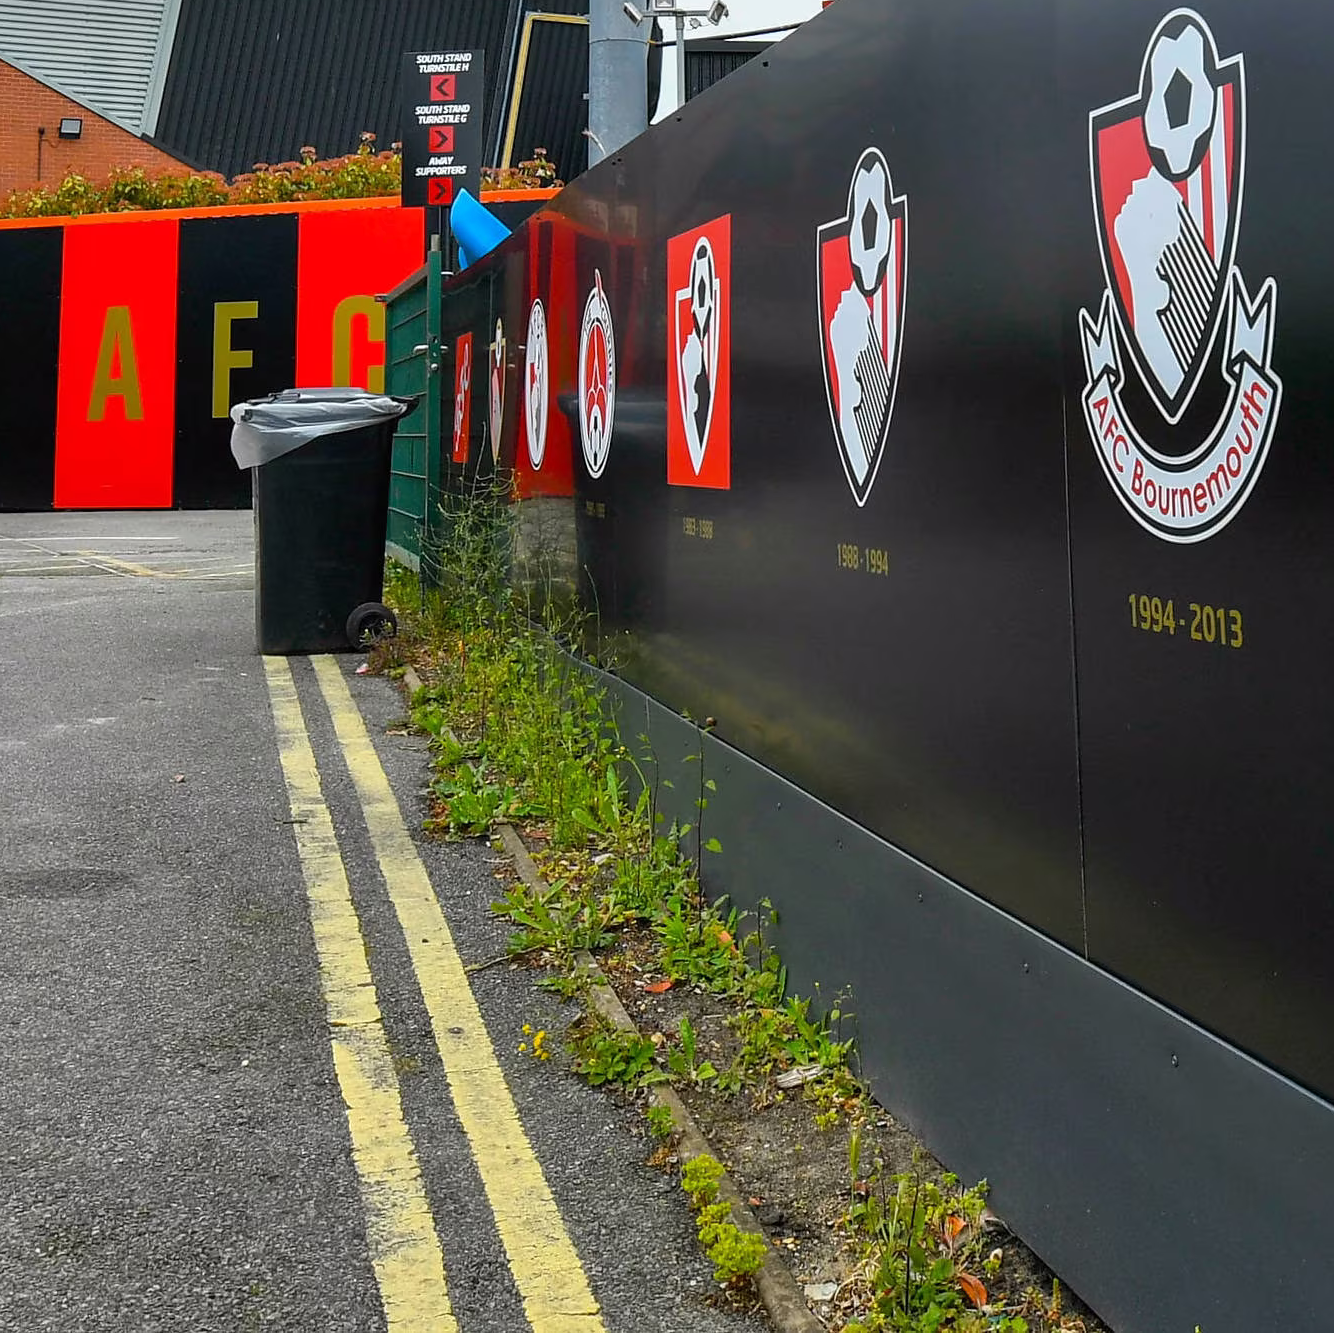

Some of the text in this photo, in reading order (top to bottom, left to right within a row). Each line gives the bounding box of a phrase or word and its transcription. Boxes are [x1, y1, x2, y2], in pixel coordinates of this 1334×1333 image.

[416, 53, 472, 63] SOUTH STAND
[419, 63, 469, 73] TURNSTILE H
[415, 104, 470, 115] SOUTH STAND
[418, 115, 460, 124] TURNSTILE
[428, 156, 454, 165] AWAY
[415, 166, 467, 176] SUPPORTERS
[1092, 381, 1268, 517] AFC Bournemouth
[1128, 593, 1176, 635] 1994
[1190, 603, 1243, 648] 2013
